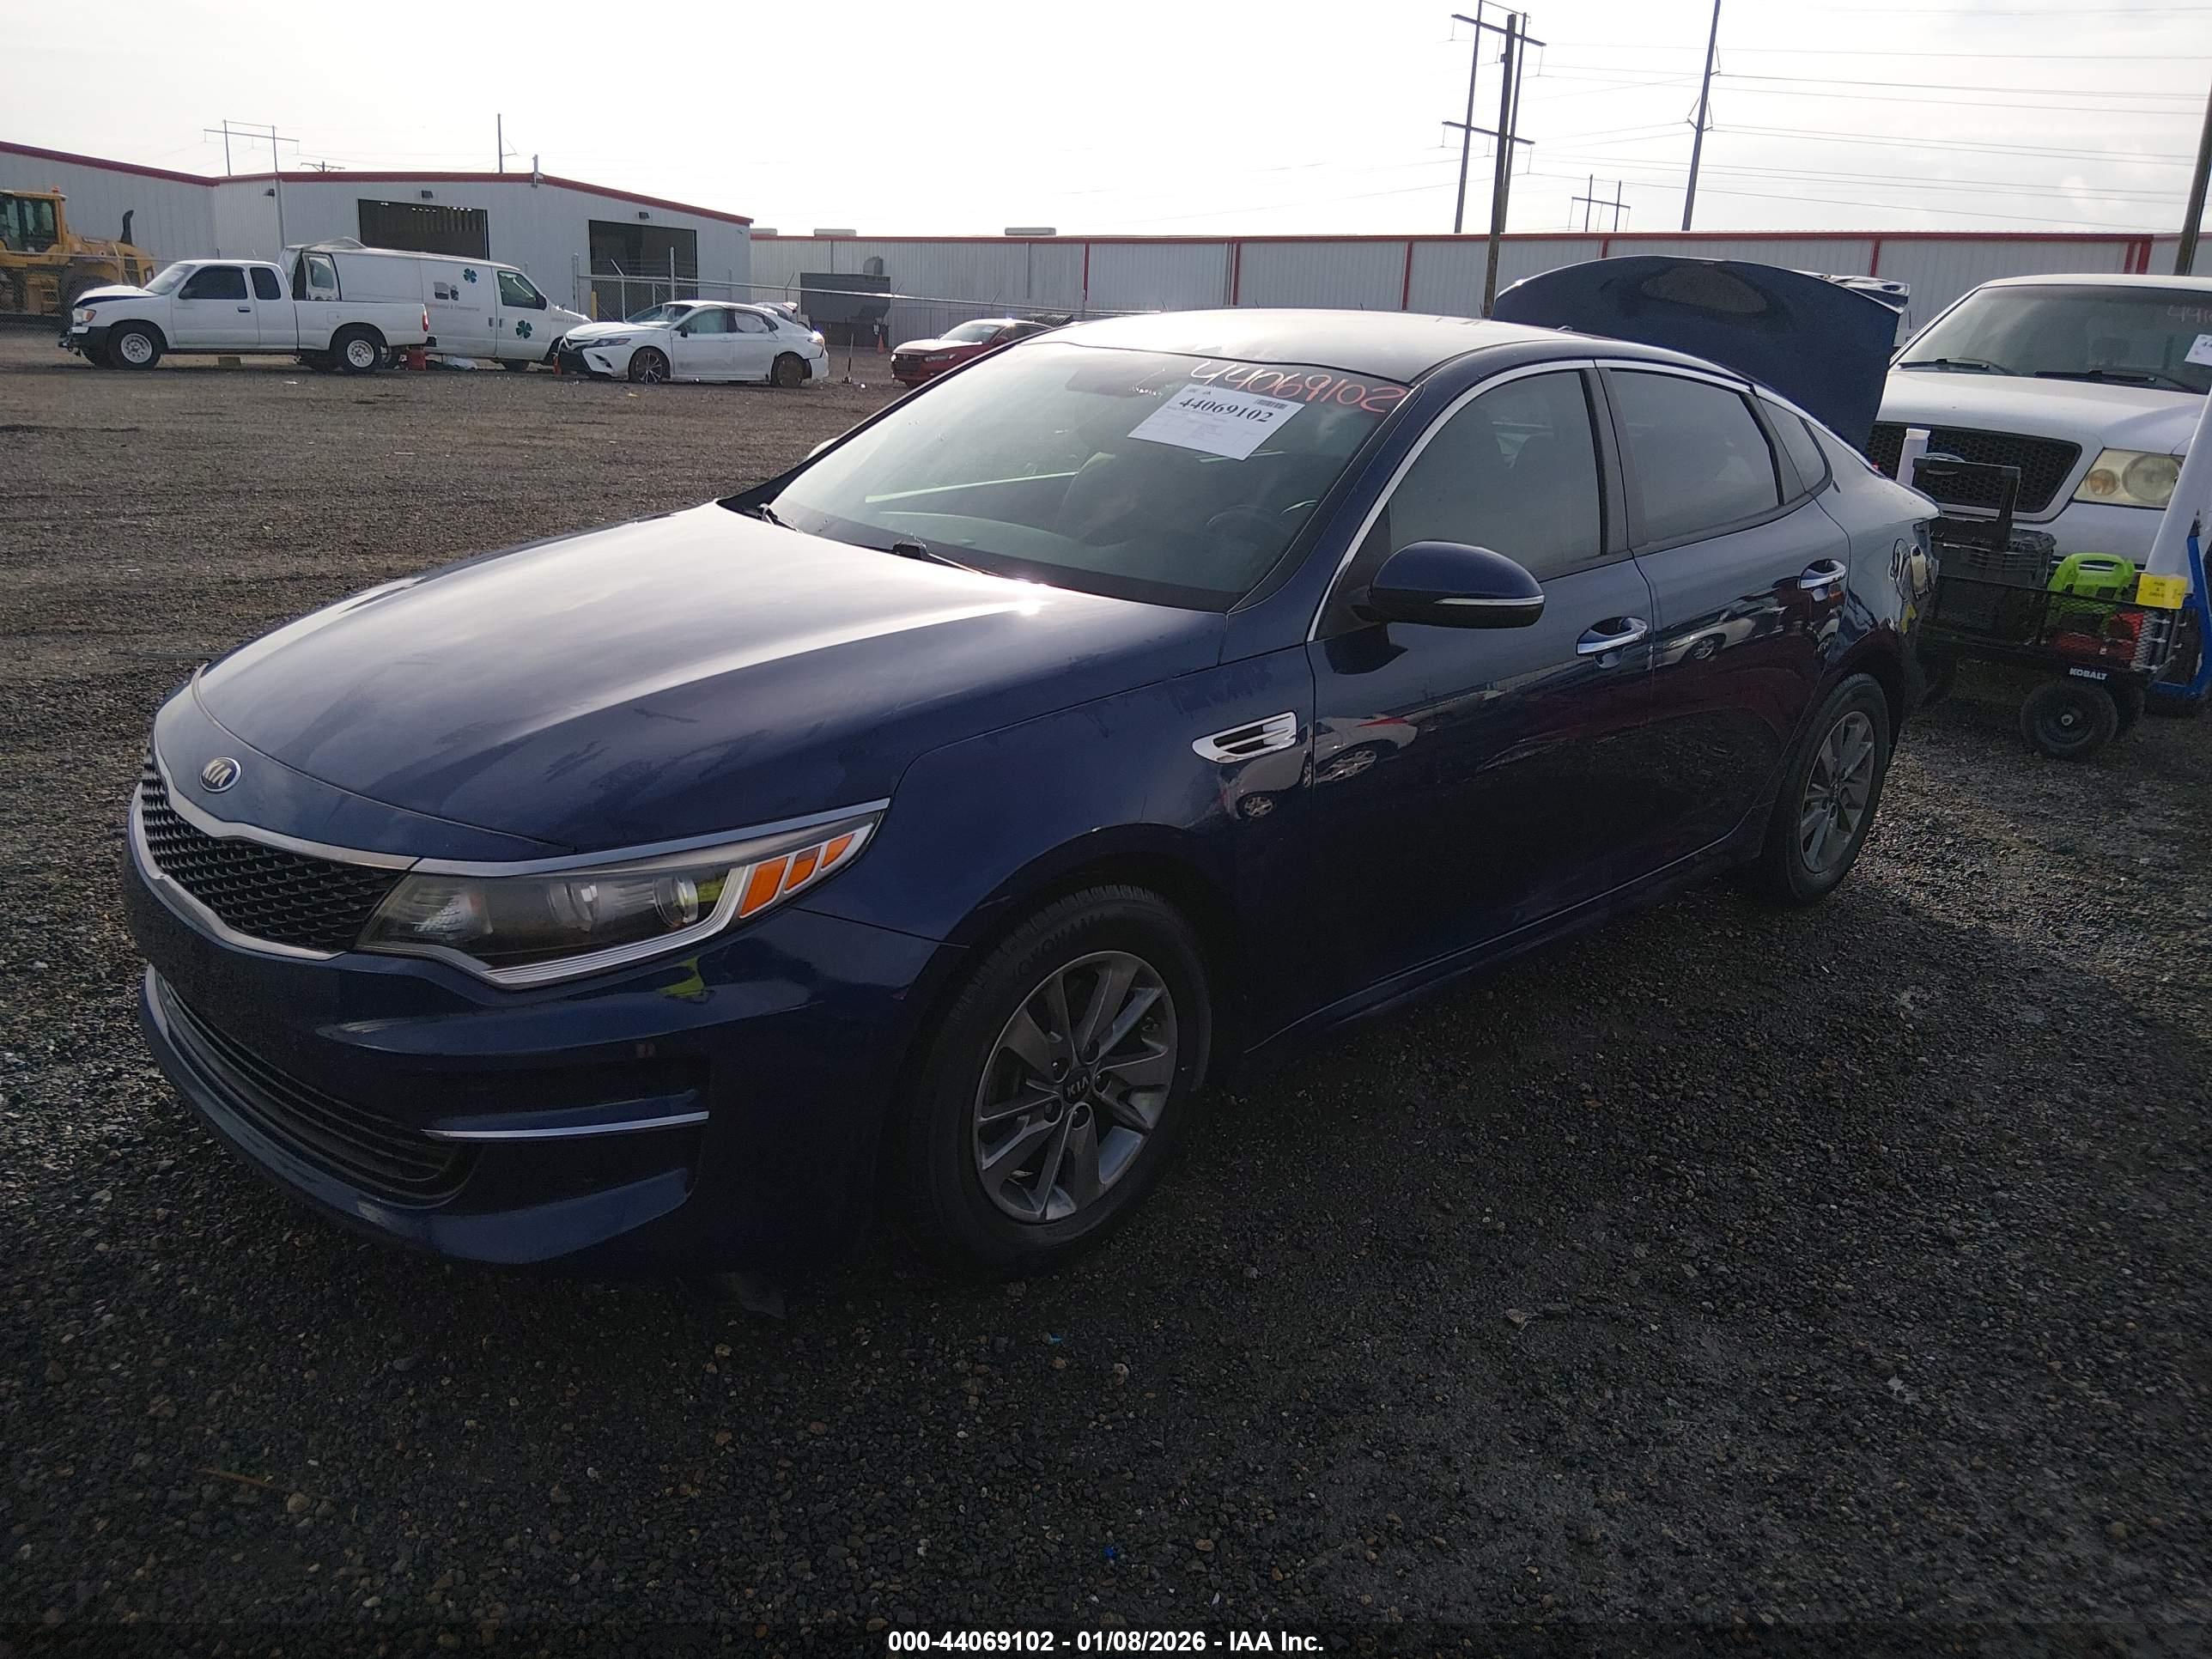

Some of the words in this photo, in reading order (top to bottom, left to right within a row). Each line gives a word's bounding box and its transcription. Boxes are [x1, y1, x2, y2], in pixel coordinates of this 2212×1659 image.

[1190, 360, 1408, 413] 44069102
[1179, 397, 1274, 423] 44069102
[2069, 667, 2108, 681] KOBALT
[1066, 1075, 1090, 1098] KIA
